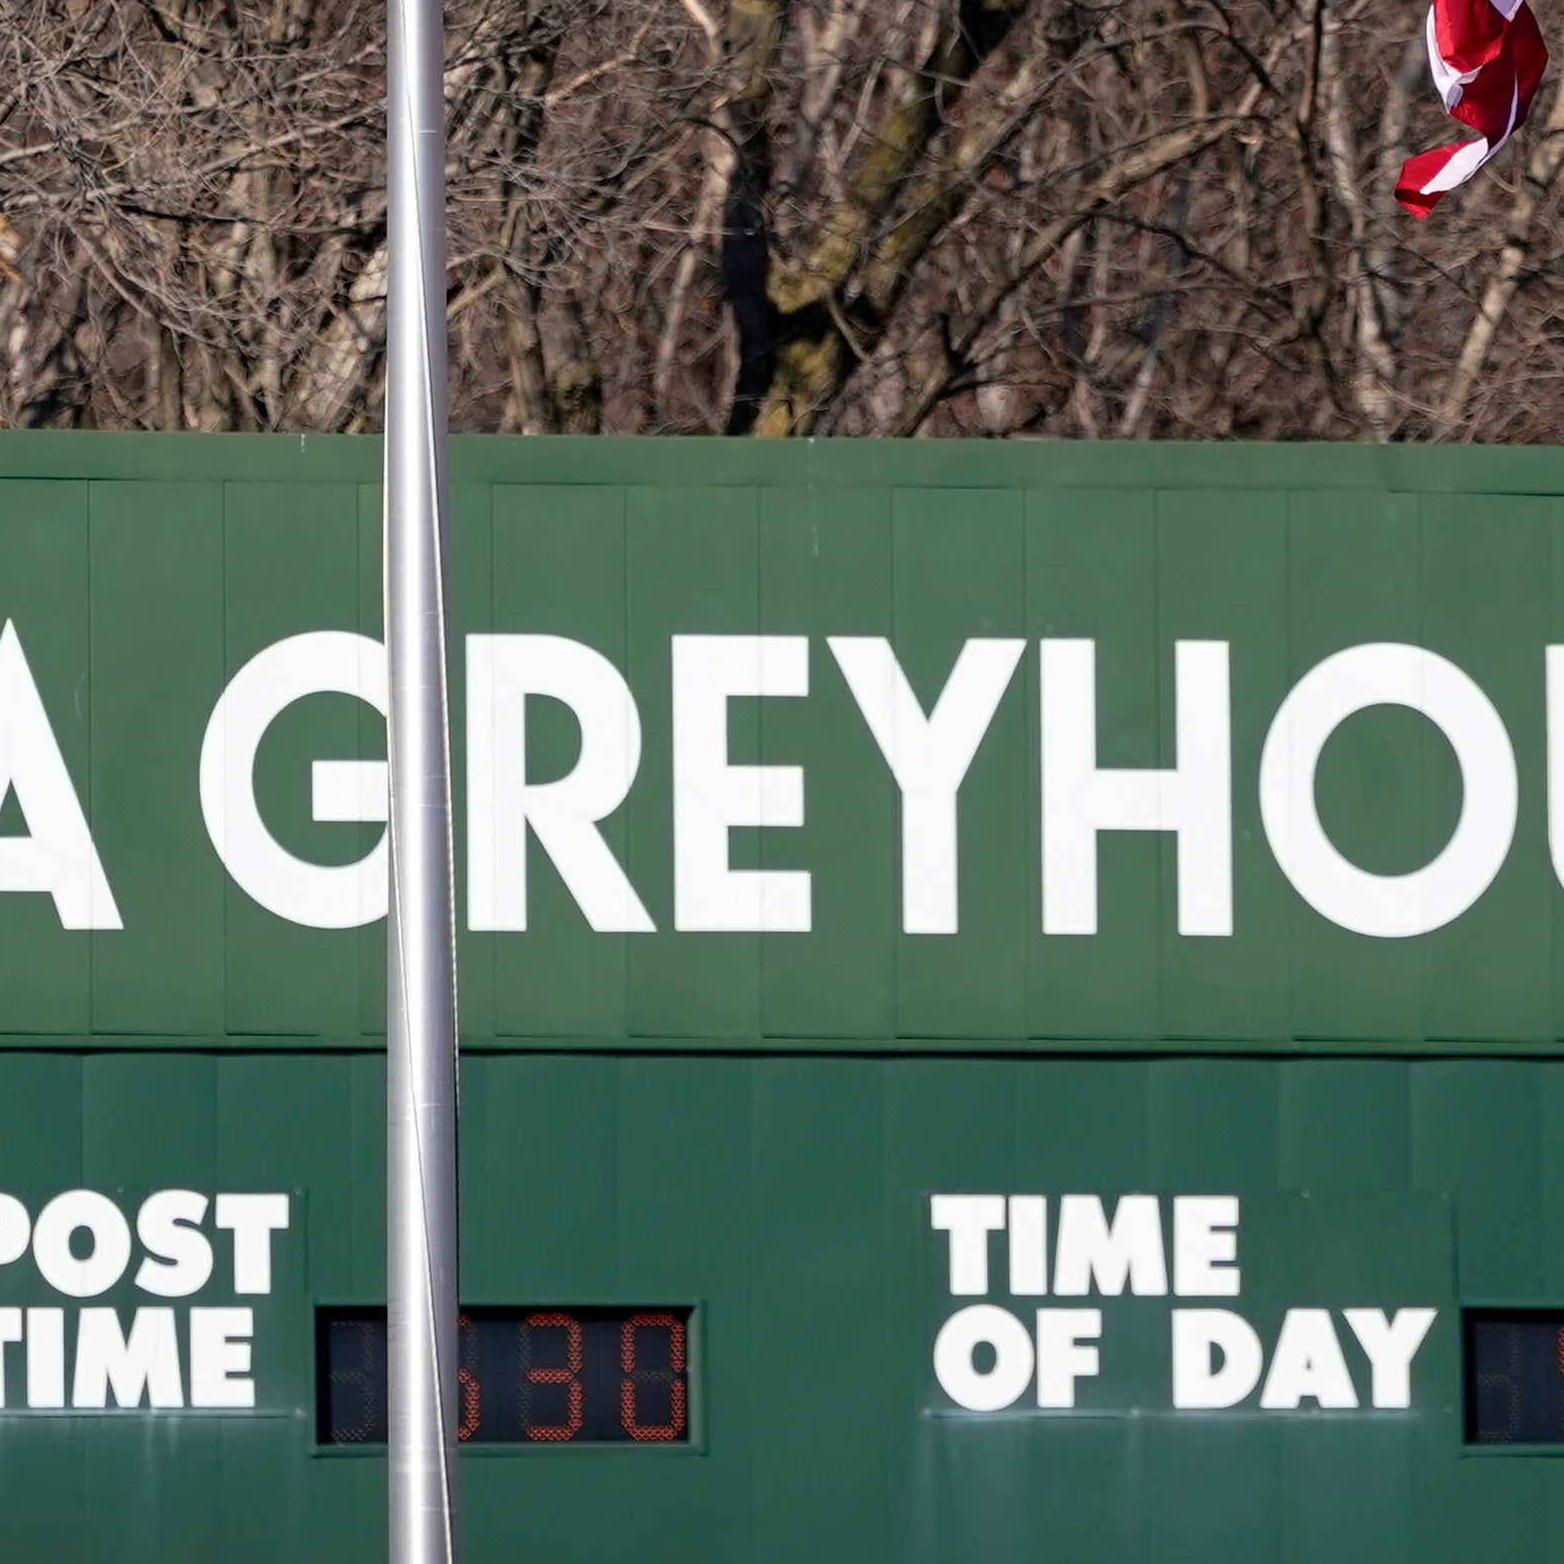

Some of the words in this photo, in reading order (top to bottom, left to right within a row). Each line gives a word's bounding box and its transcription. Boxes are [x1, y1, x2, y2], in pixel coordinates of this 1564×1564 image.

[930, 1194, 1241, 1297] TIME
[933, 1303, 1102, 1412] OF
[1171, 1307, 1438, 1410] DAY
